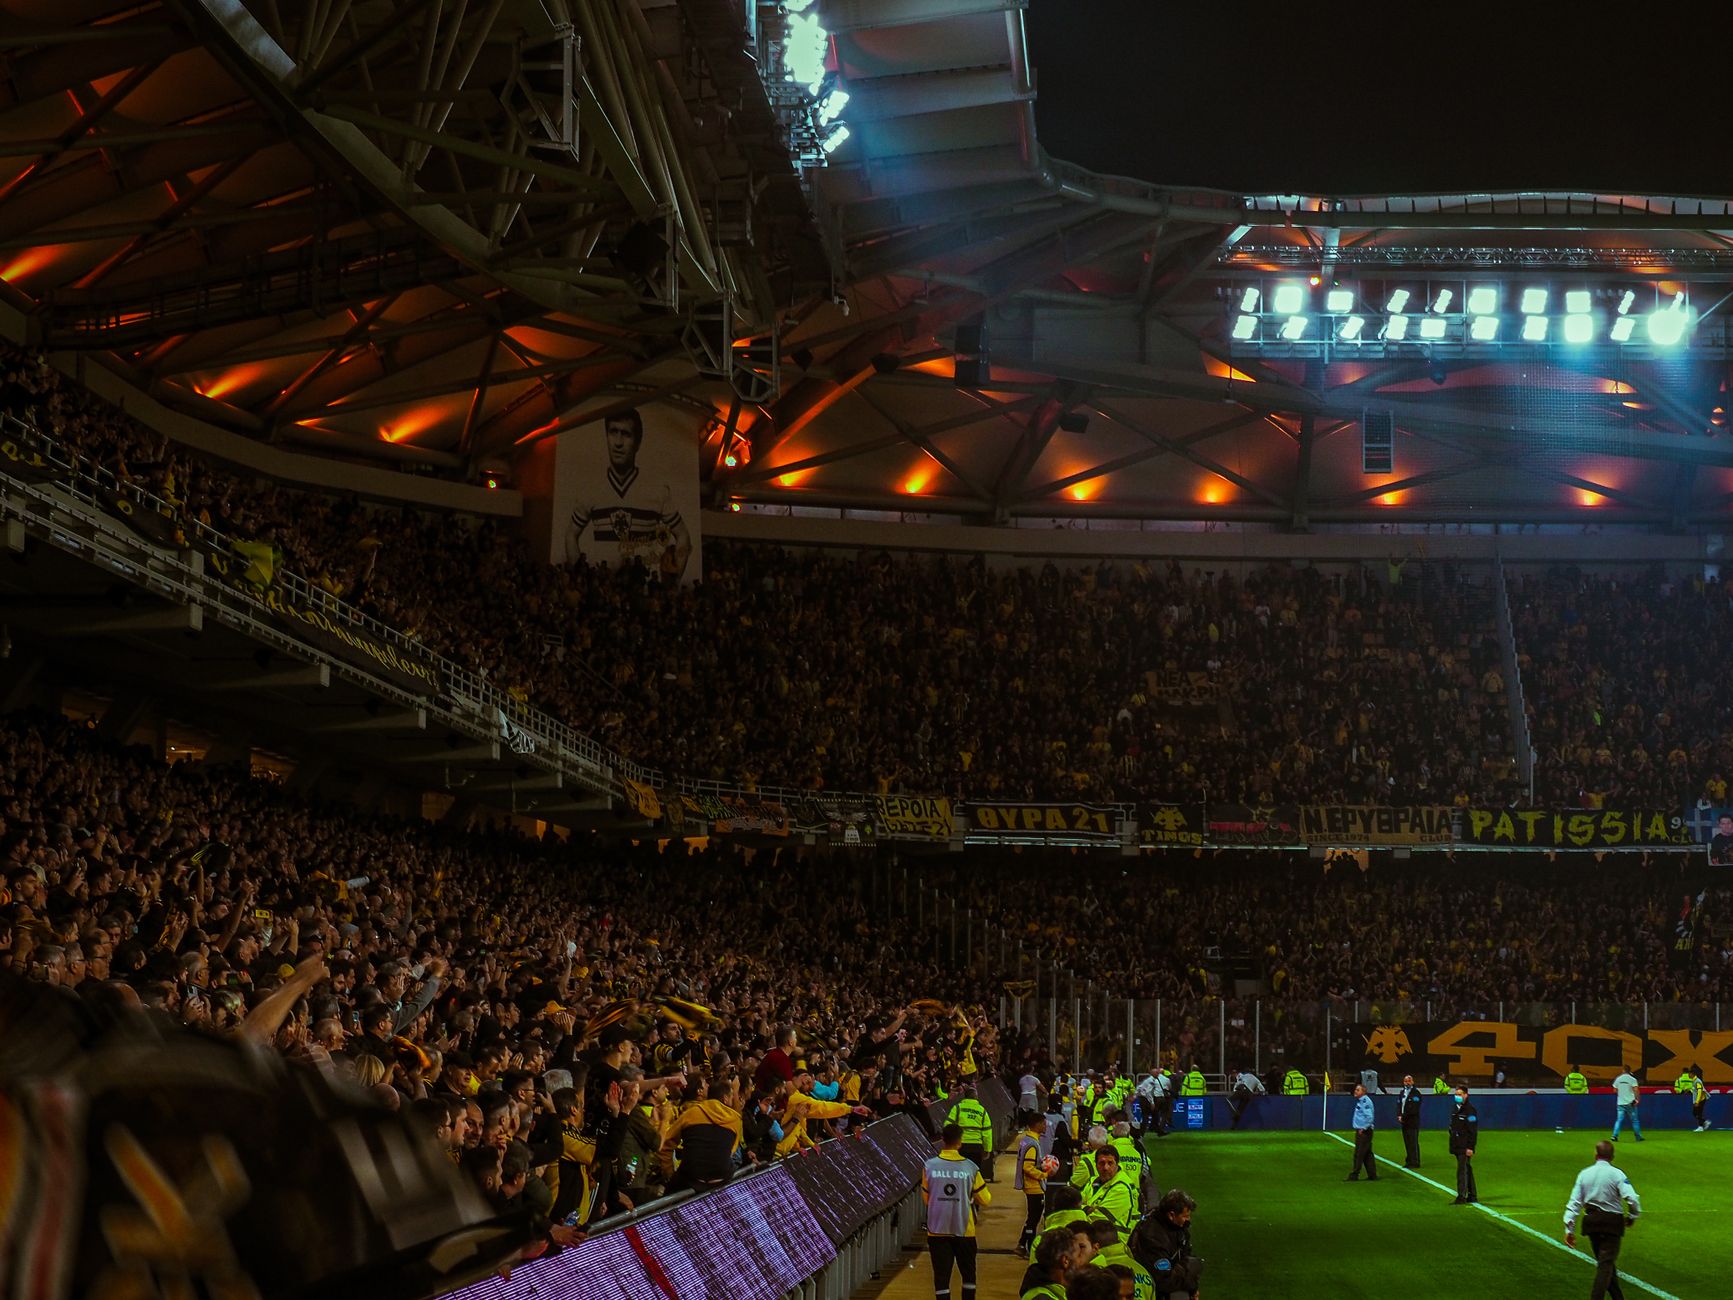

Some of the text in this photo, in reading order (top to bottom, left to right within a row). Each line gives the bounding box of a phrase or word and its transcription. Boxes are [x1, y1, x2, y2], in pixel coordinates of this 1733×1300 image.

[977, 806, 1110, 833] ΘΥΡΑ 21
[1468, 808, 1670, 846] PATISSIA
[1308, 833, 1344, 842] SINCE
[931, 1170, 971, 1180] BALL BOY
